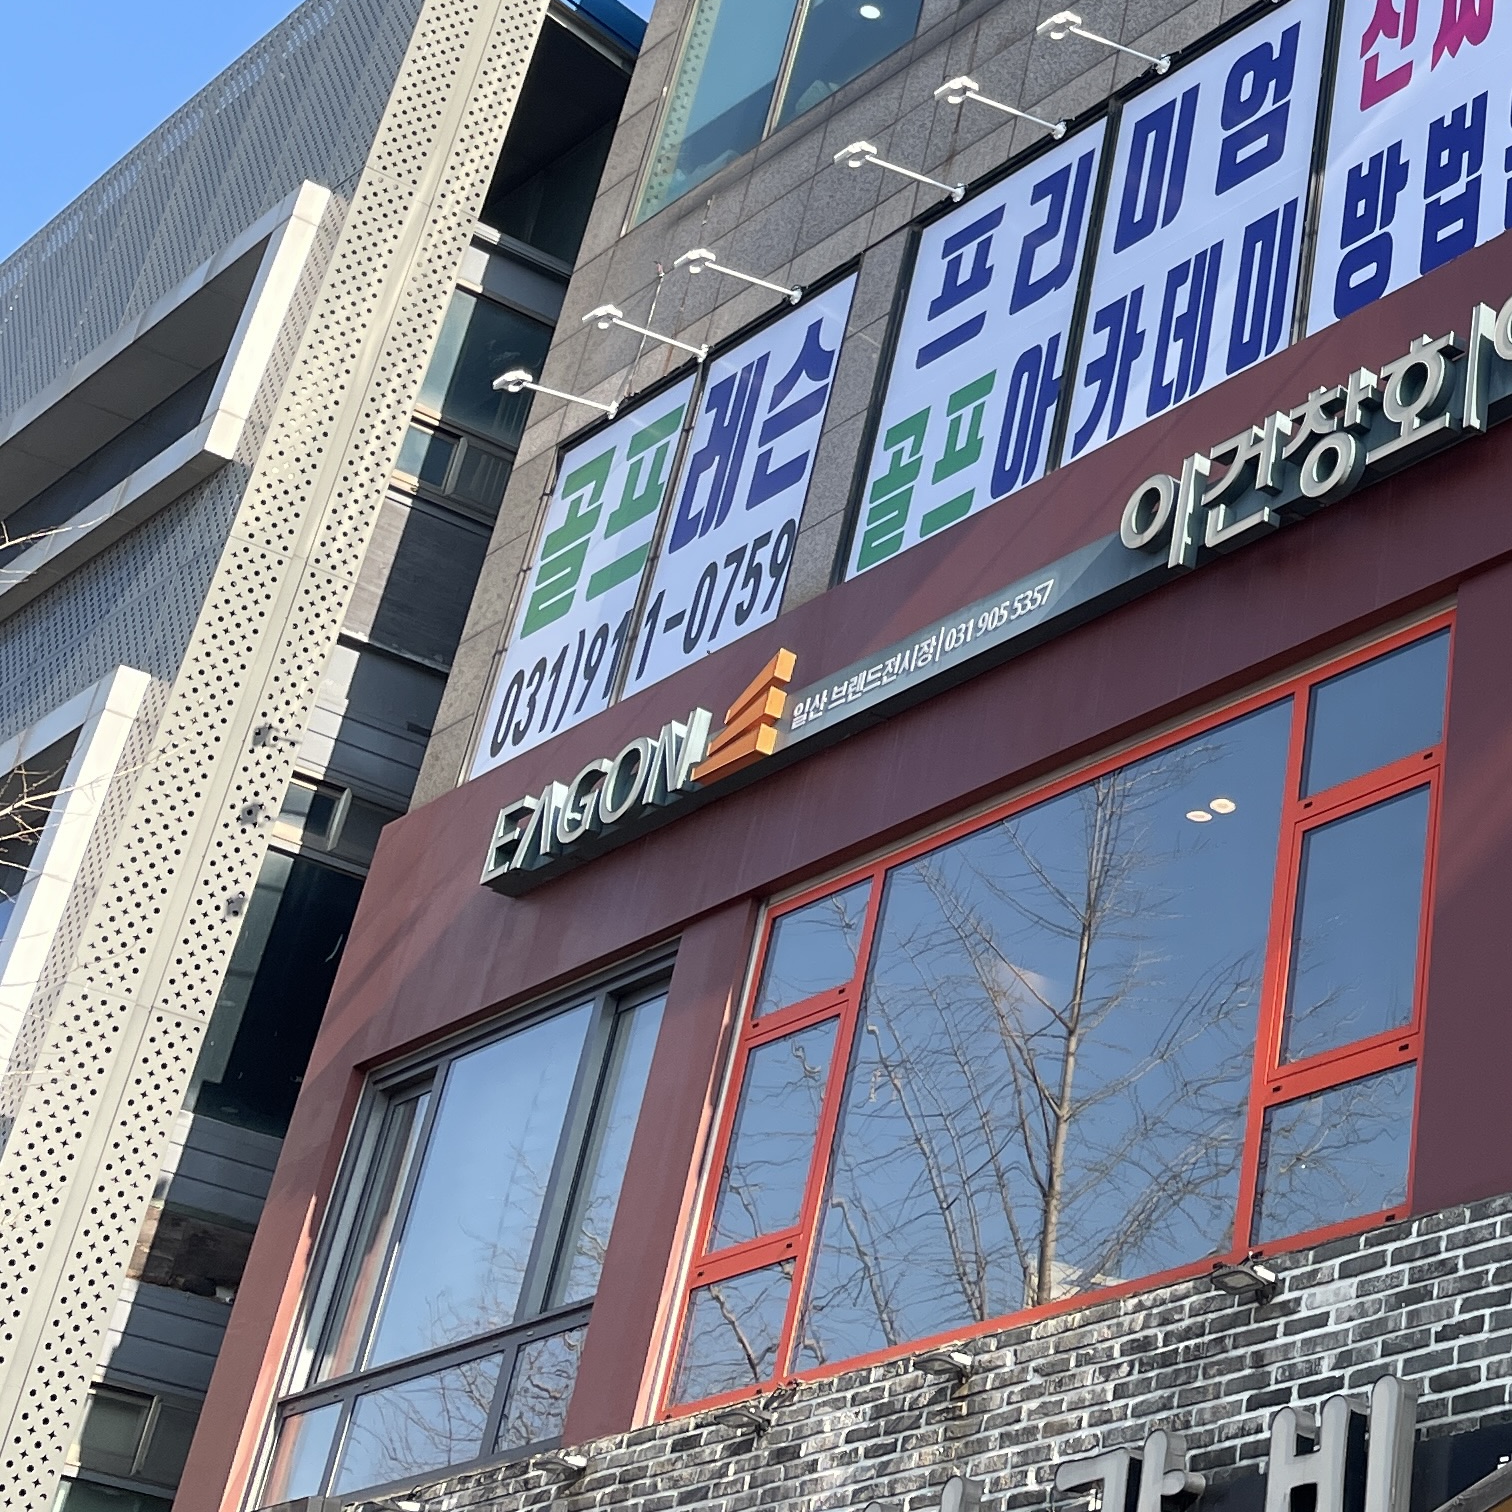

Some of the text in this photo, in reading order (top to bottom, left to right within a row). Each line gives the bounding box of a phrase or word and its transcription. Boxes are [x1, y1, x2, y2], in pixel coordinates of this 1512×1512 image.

[915, 19, 1302, 371] 프리미엄
[488, 517, 797, 759] 031)911-0759
[790, 689, 828, 731] 일산
[944, 618, 975, 654] 031
[976, 600, 1010, 638] 905
[1009, 578, 1055, 621] 5357
[480, 707, 713, 886] EAGON
